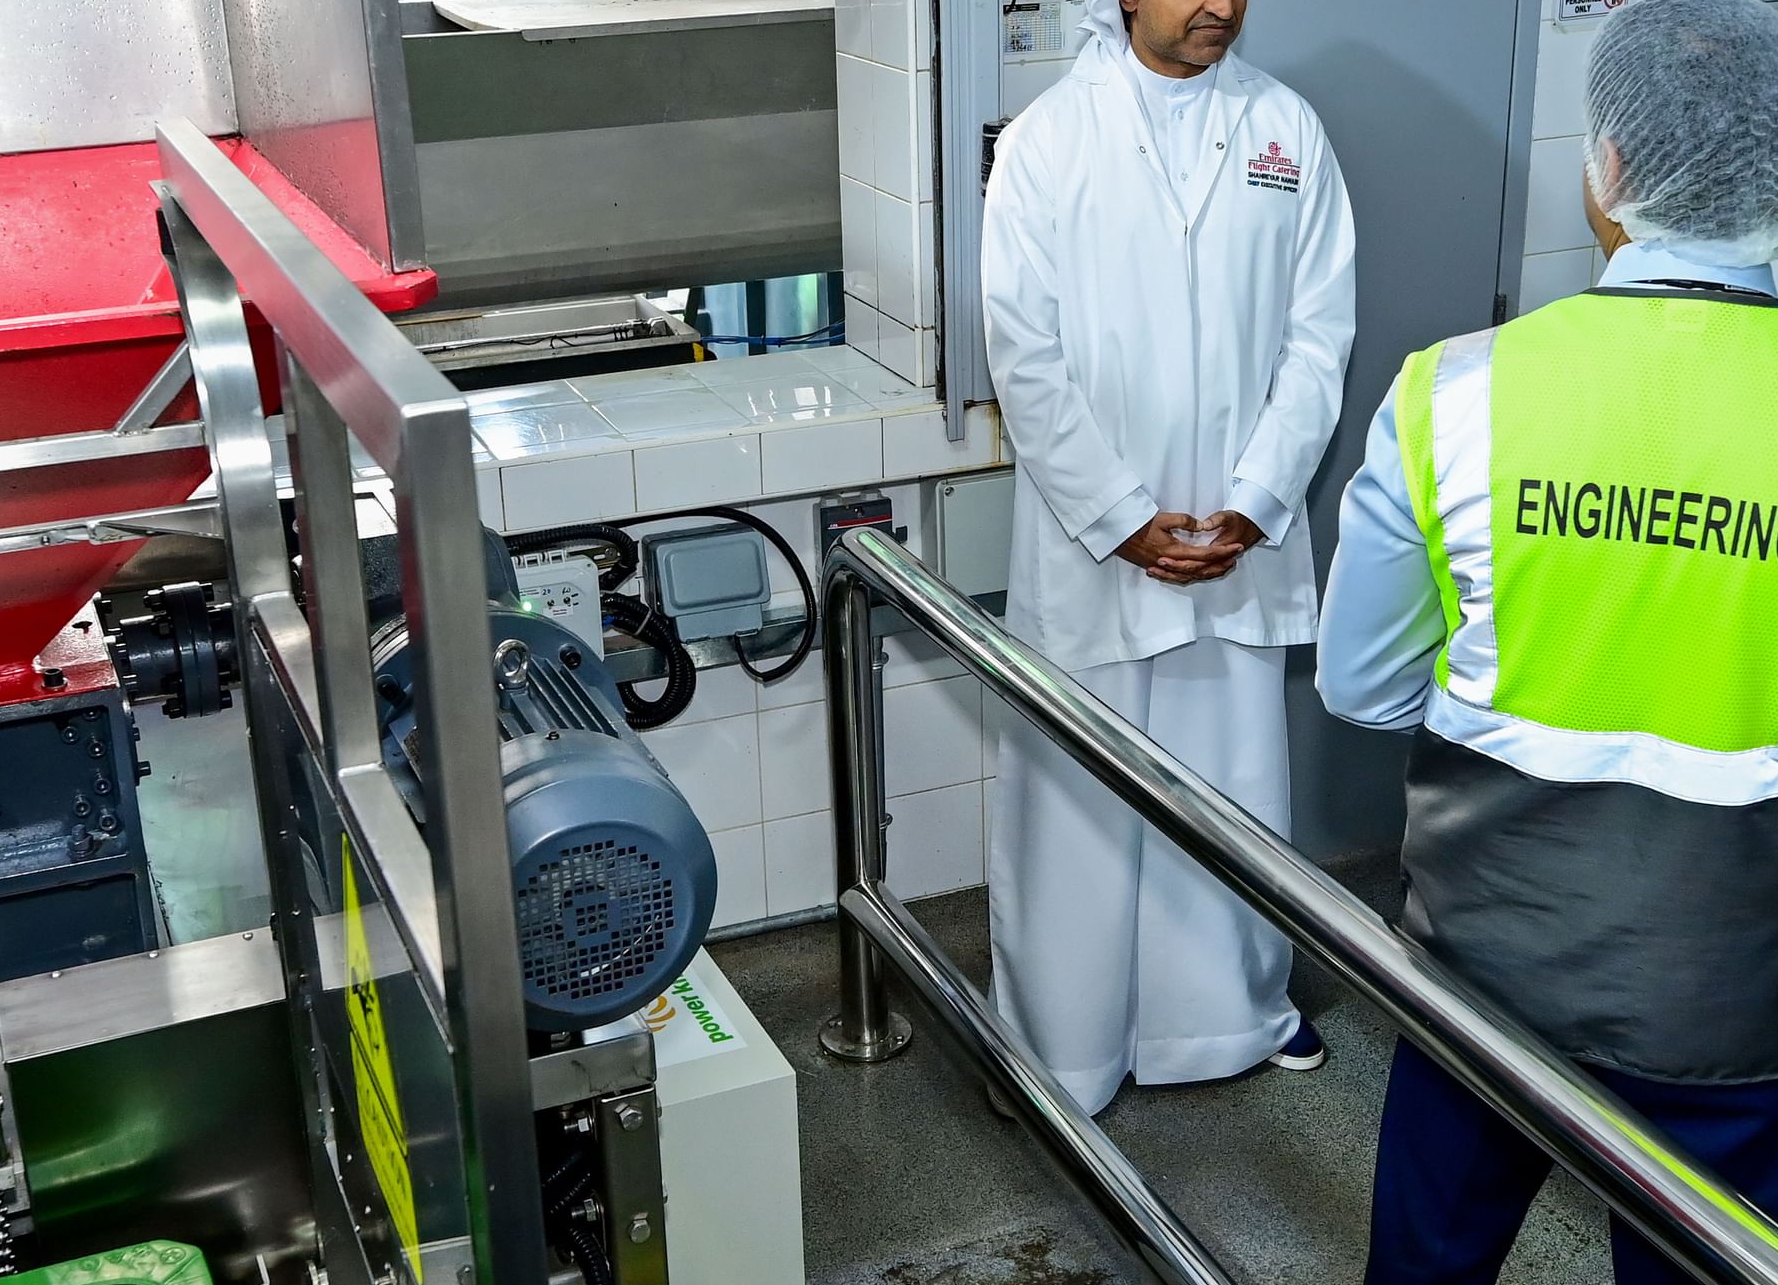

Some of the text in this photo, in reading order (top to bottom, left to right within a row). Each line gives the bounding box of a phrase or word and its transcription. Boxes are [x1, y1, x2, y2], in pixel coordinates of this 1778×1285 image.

[1575, 4, 1591, 14] ONLY
[1259, 153, 1292, 165] Emirates
[1248, 162, 1300, 178] Flight Catering
[681, 995, 734, 1043] power
